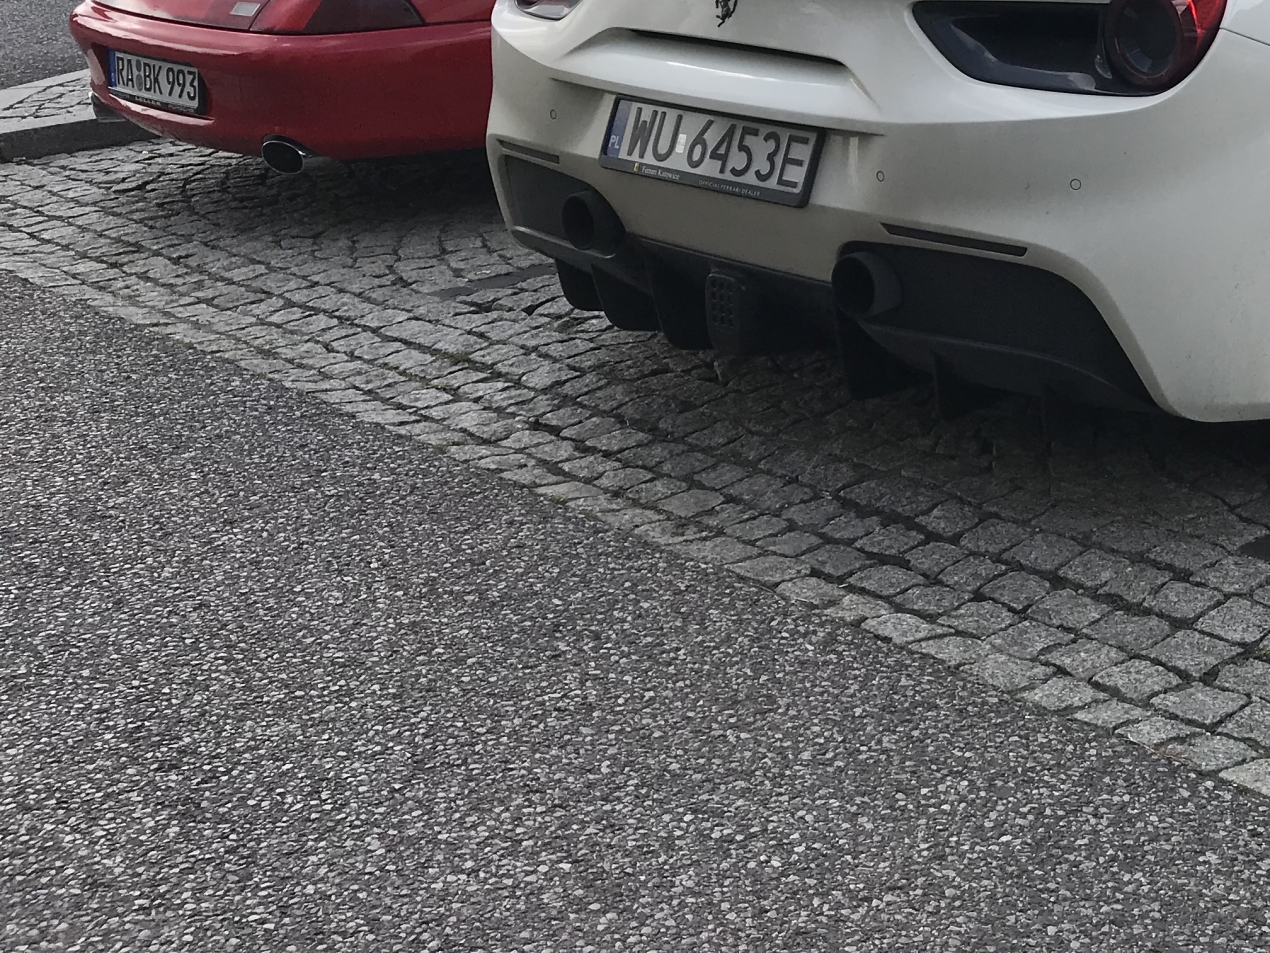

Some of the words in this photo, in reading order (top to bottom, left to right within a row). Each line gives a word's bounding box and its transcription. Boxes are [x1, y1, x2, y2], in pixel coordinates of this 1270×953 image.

[116, 56, 135, 89] RA
[142, 61, 163, 95] BK
[165, 66, 197, 101] 993
[609, 136, 620, 149] PL
[626, 106, 683, 163] WU
[686, 118, 810, 189] 6453E
